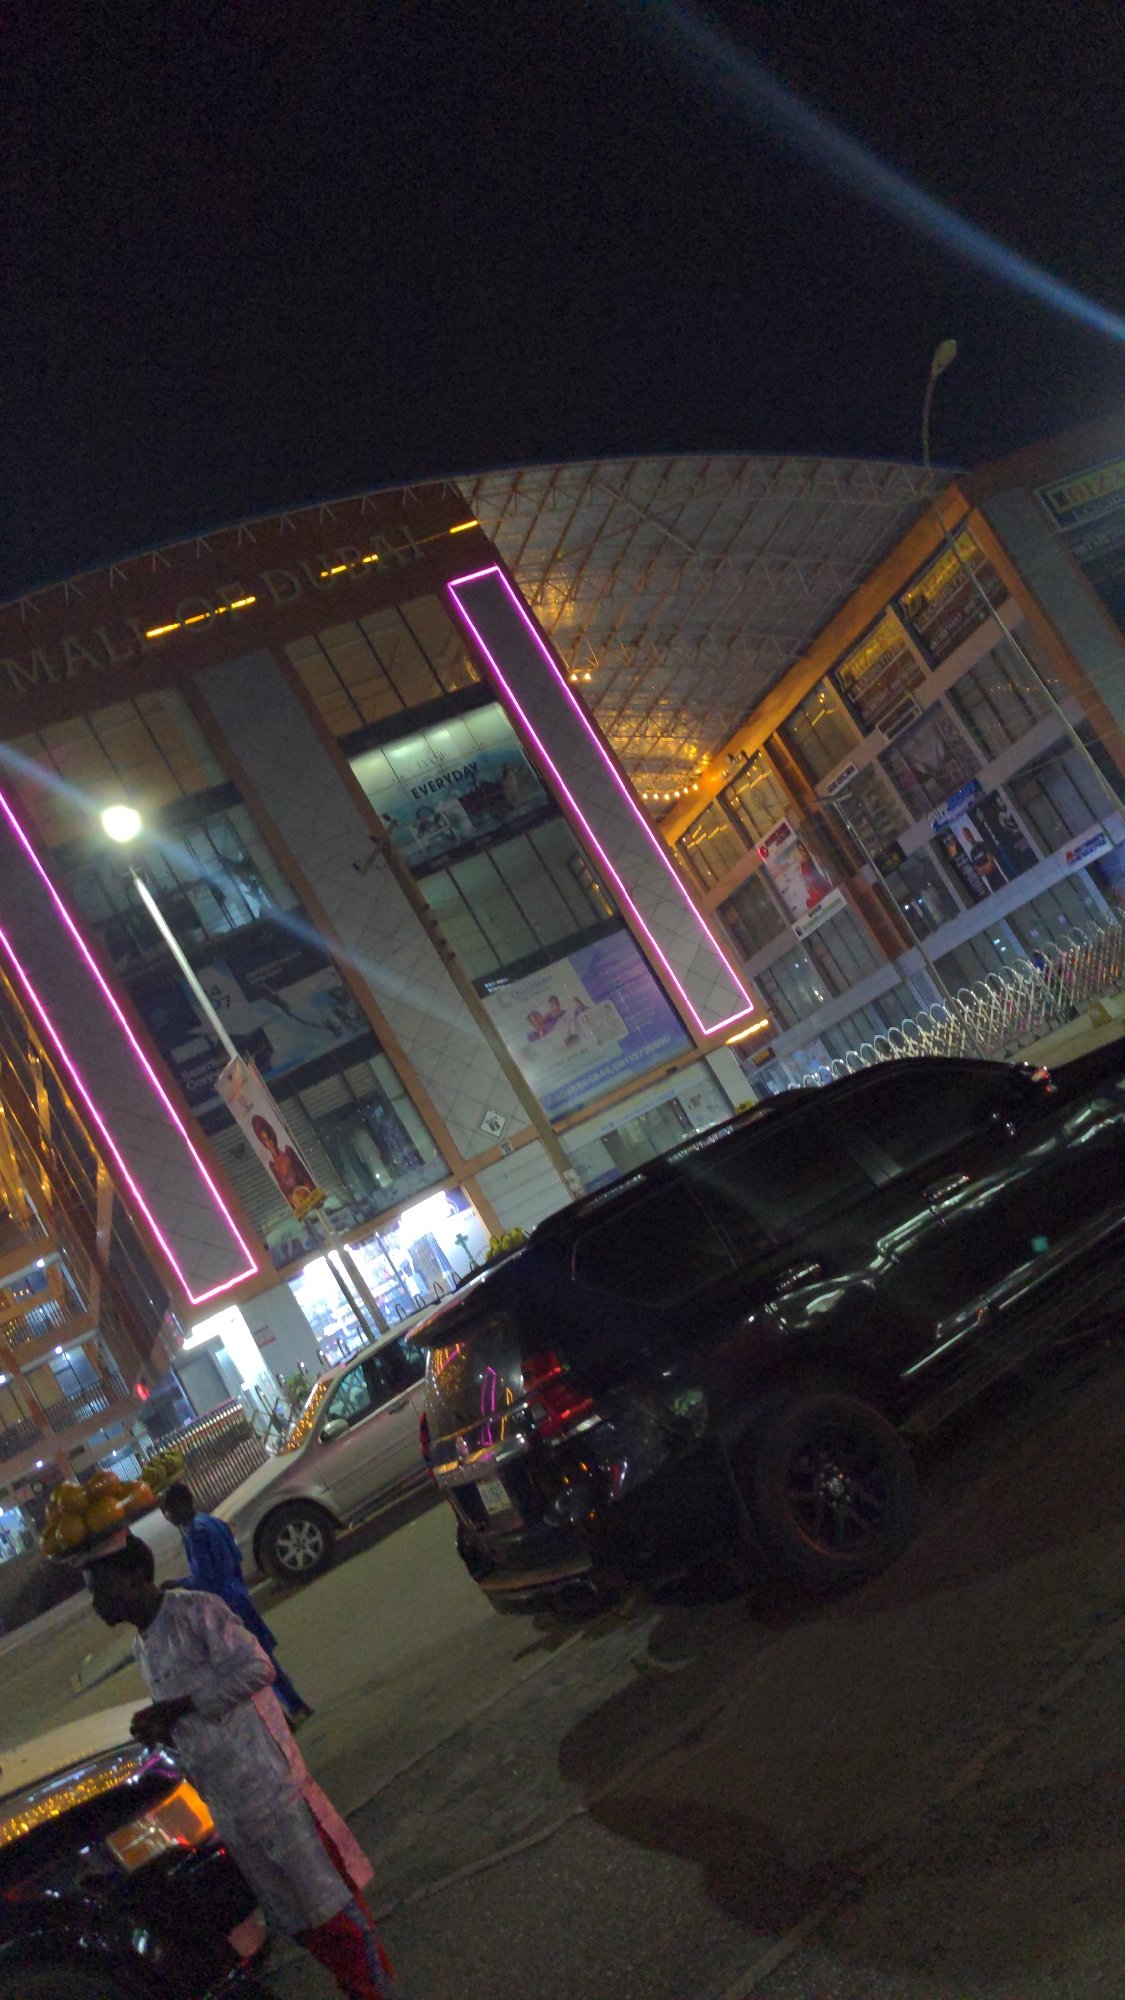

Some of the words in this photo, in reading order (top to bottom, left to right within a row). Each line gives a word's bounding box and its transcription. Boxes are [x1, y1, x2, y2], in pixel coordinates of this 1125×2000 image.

[1, 618, 167, 692] MALL
[176, 580, 252, 634] OF
[258, 525, 425, 605] DUBAI
[411, 761, 479, 799] EVERYDAY
